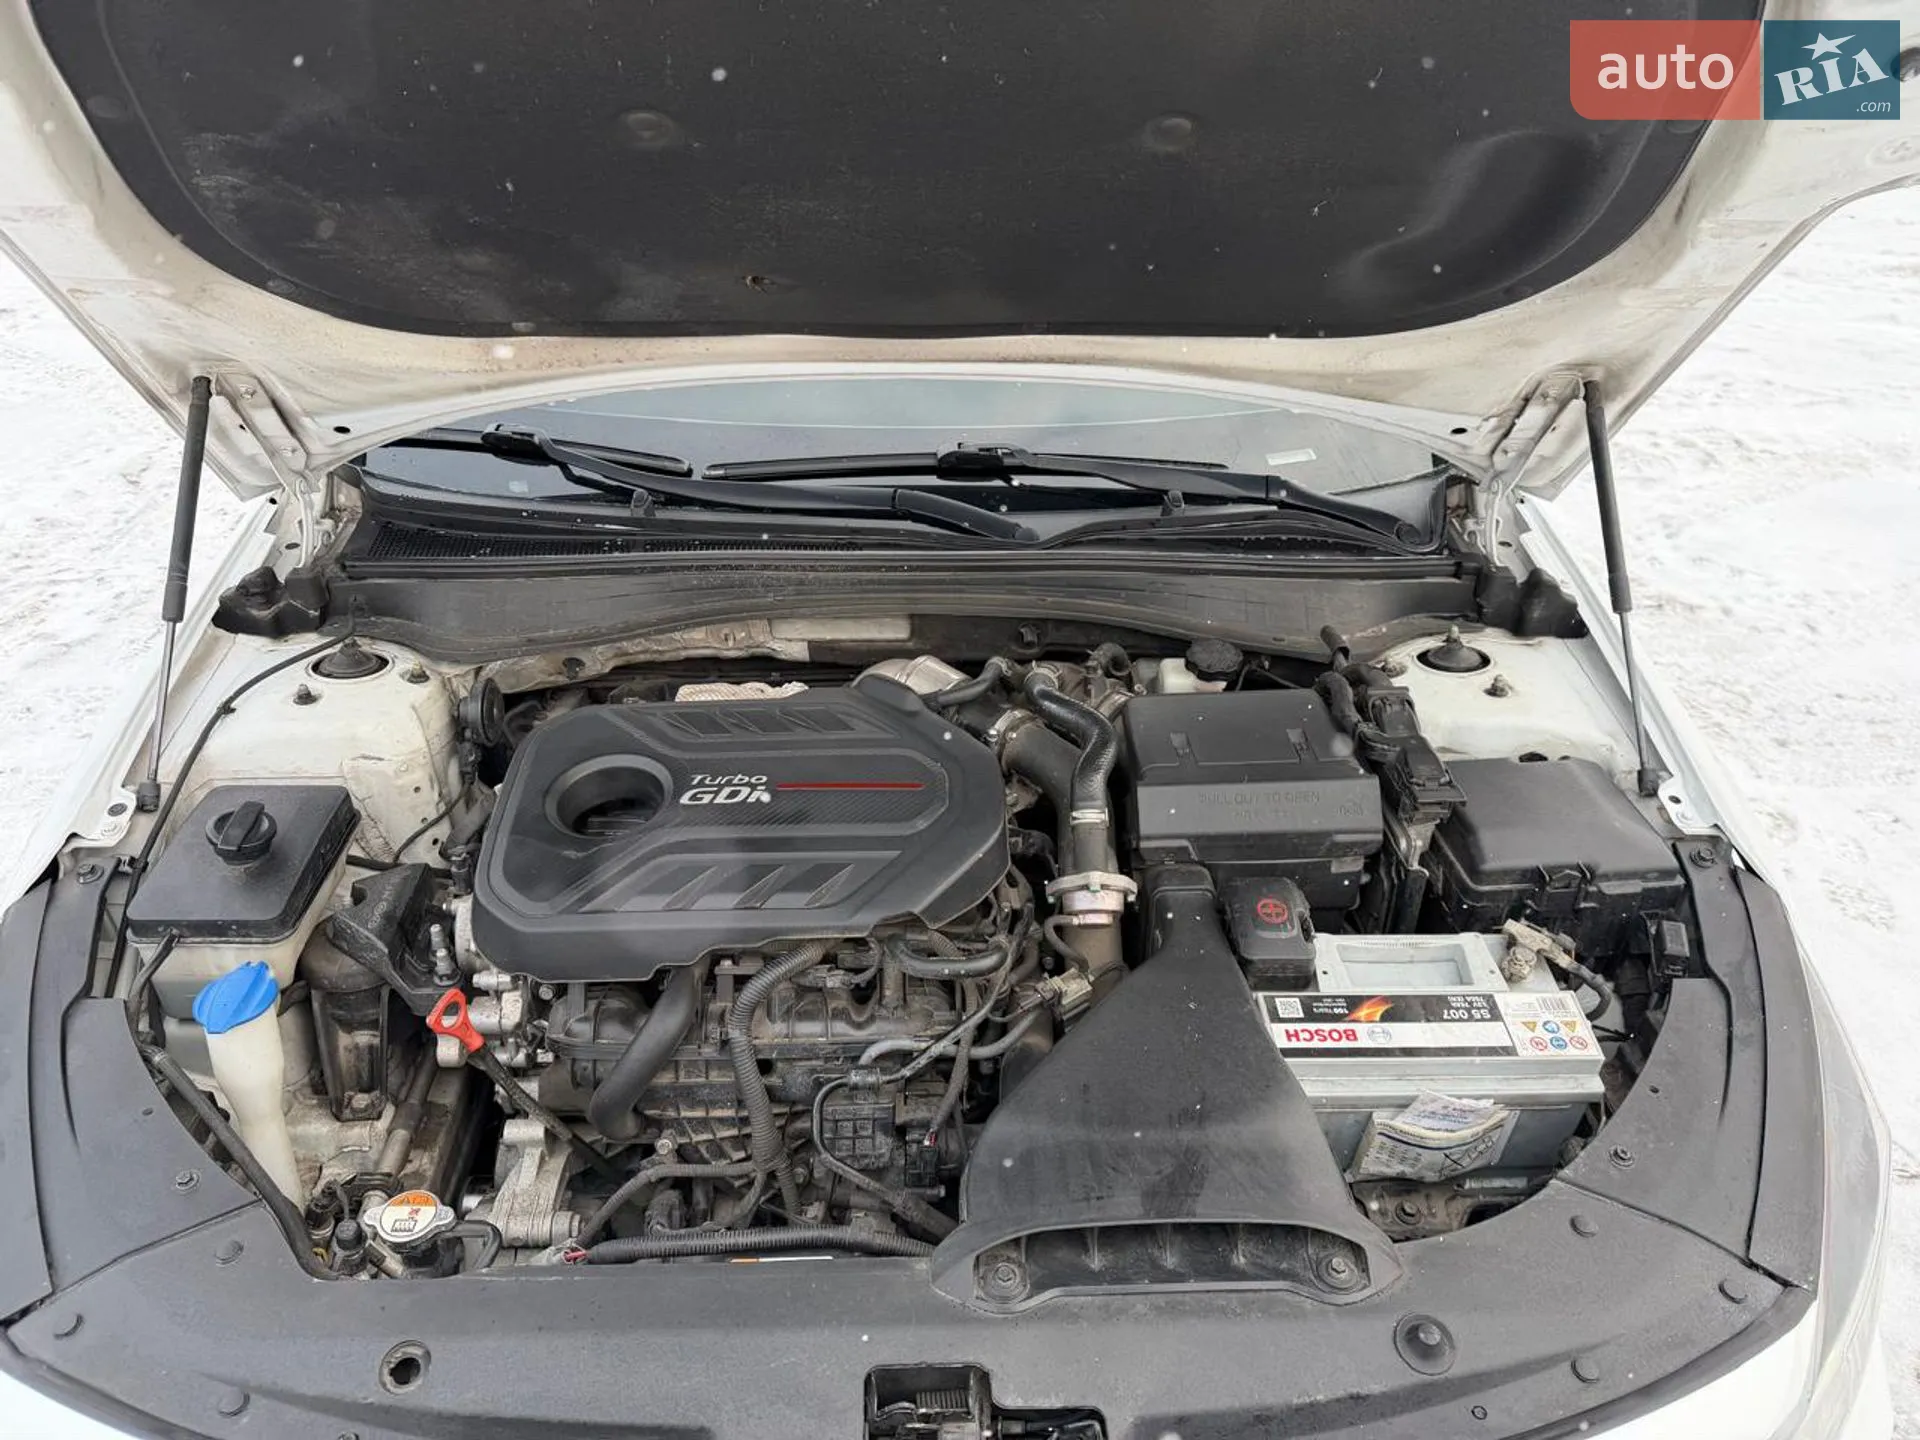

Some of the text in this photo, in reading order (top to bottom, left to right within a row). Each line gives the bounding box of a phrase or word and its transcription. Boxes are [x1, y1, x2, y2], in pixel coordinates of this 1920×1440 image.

[690, 774, 768, 786] Turbo
[1442, 1008, 1468, 1020] 007
[1471, 1008, 1491, 1020] S5
[1284, 1028, 1359, 1043] BOSCH
